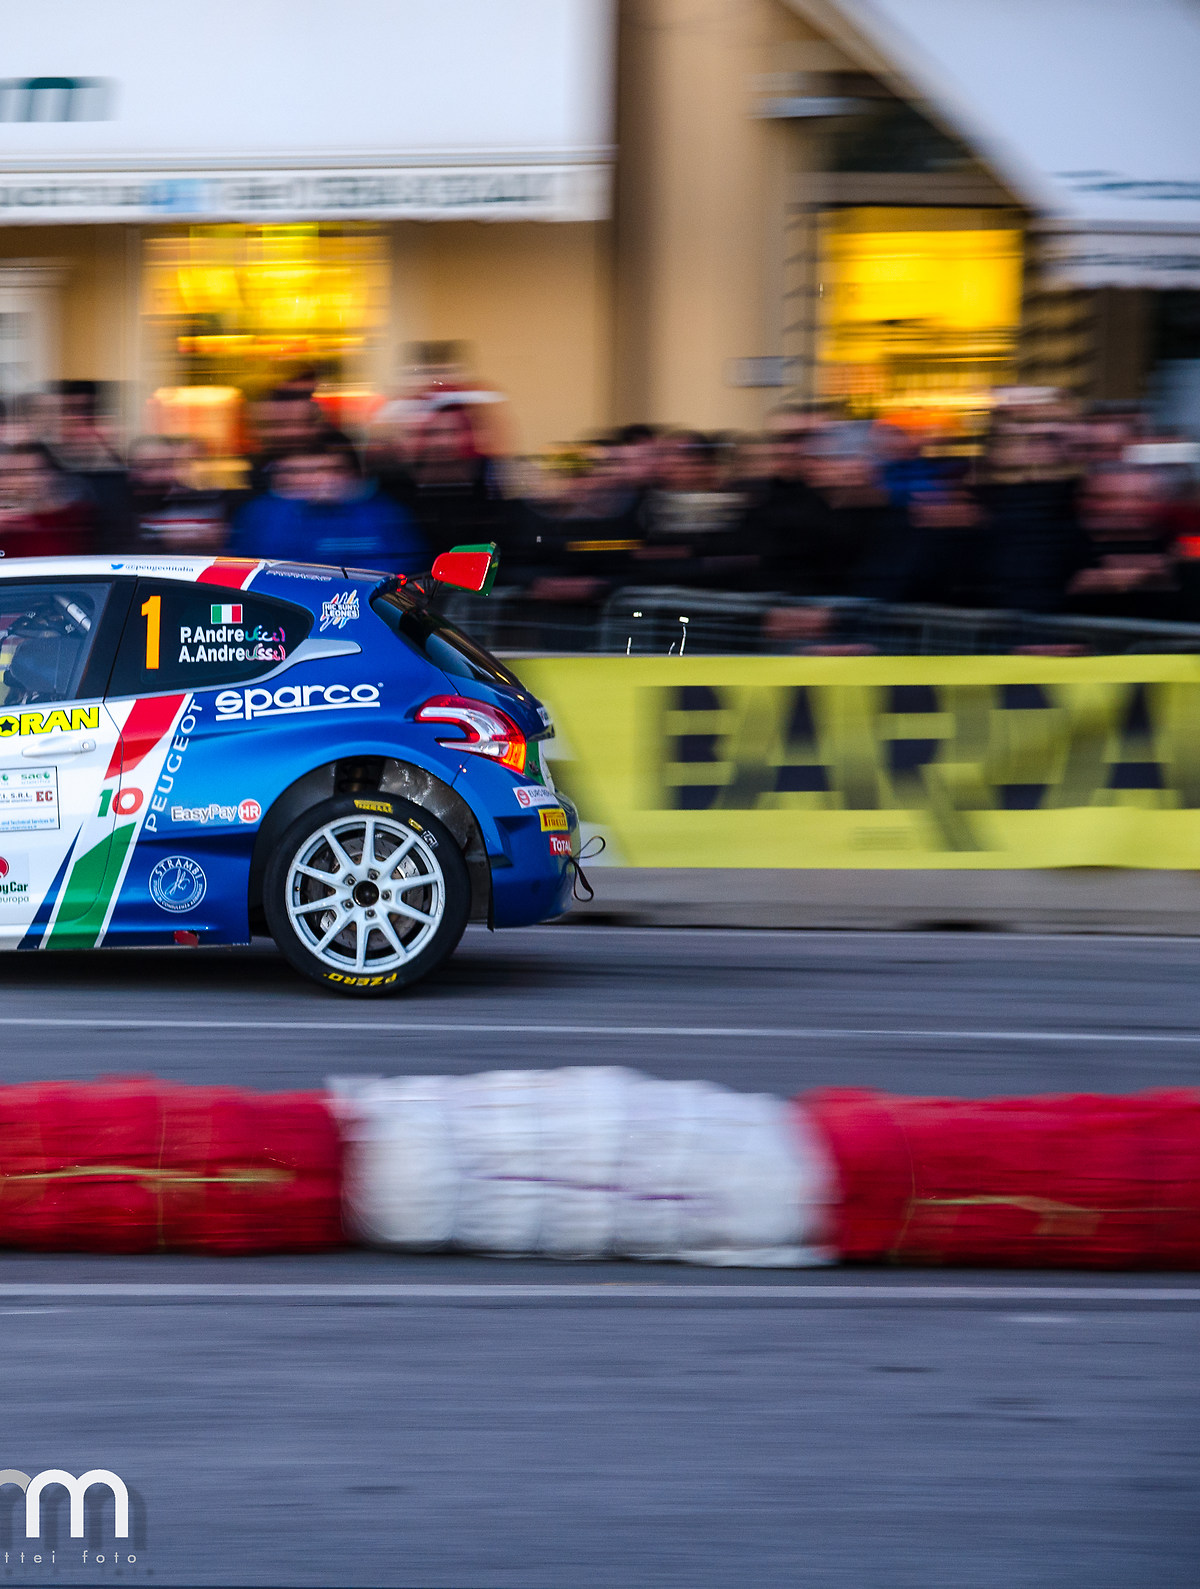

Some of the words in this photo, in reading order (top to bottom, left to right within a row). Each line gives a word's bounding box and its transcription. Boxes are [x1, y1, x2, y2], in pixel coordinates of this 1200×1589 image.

[141, 595, 161, 670] 1
[215, 683, 381, 721] sparco
[145, 698, 202, 832] PEUGEOT
[36, 790, 53, 802] EC
[97, 787, 144, 817] 10
[171, 803, 239, 824] EasyPay
[240, 806, 259, 818] HR
[550, 837, 572, 852] TOTAL
[155, 858, 203, 879] STRAMBI
